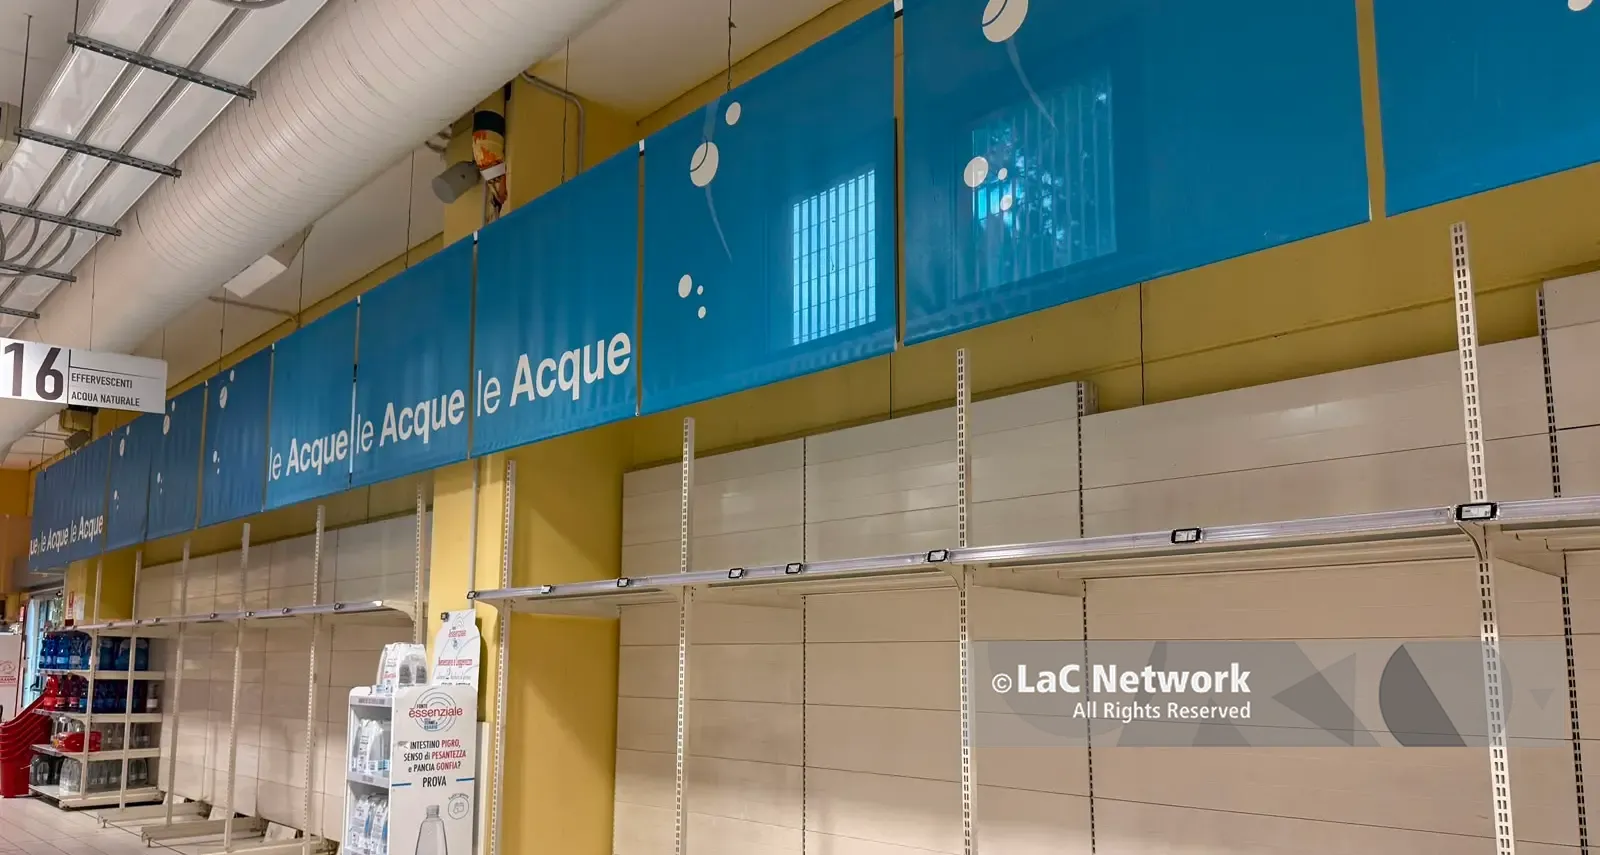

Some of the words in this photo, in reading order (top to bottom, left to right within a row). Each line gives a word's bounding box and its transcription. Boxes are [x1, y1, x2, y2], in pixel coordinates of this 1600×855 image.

[4, 342, 64, 401] 16
[71, 372, 133, 389] EFFERVESCENTI
[476, 369, 501, 417] le
[509, 332, 631, 407] Acque
[71, 391, 98, 403] ACQUA
[100, 394, 140, 407] NATURALE
[356, 413, 374, 454] le
[379, 388, 465, 447] Acque
[268, 446, 283, 482] le
[286, 429, 348, 477] Acque
[70, 520, 77, 543] le
[78, 515, 104, 543] Acque
[46, 527, 69, 553] Acque
[403, 752, 423, 762] SENSO
[424, 751, 431, 760] di
[431, 749, 467, 760] PESANTEZZA
[409, 740, 440, 750] INTESTINO
[413, 763, 435, 773] PANCIA
[435, 760, 462, 771] GONFIA?
[422, 775, 447, 788] PROVA
